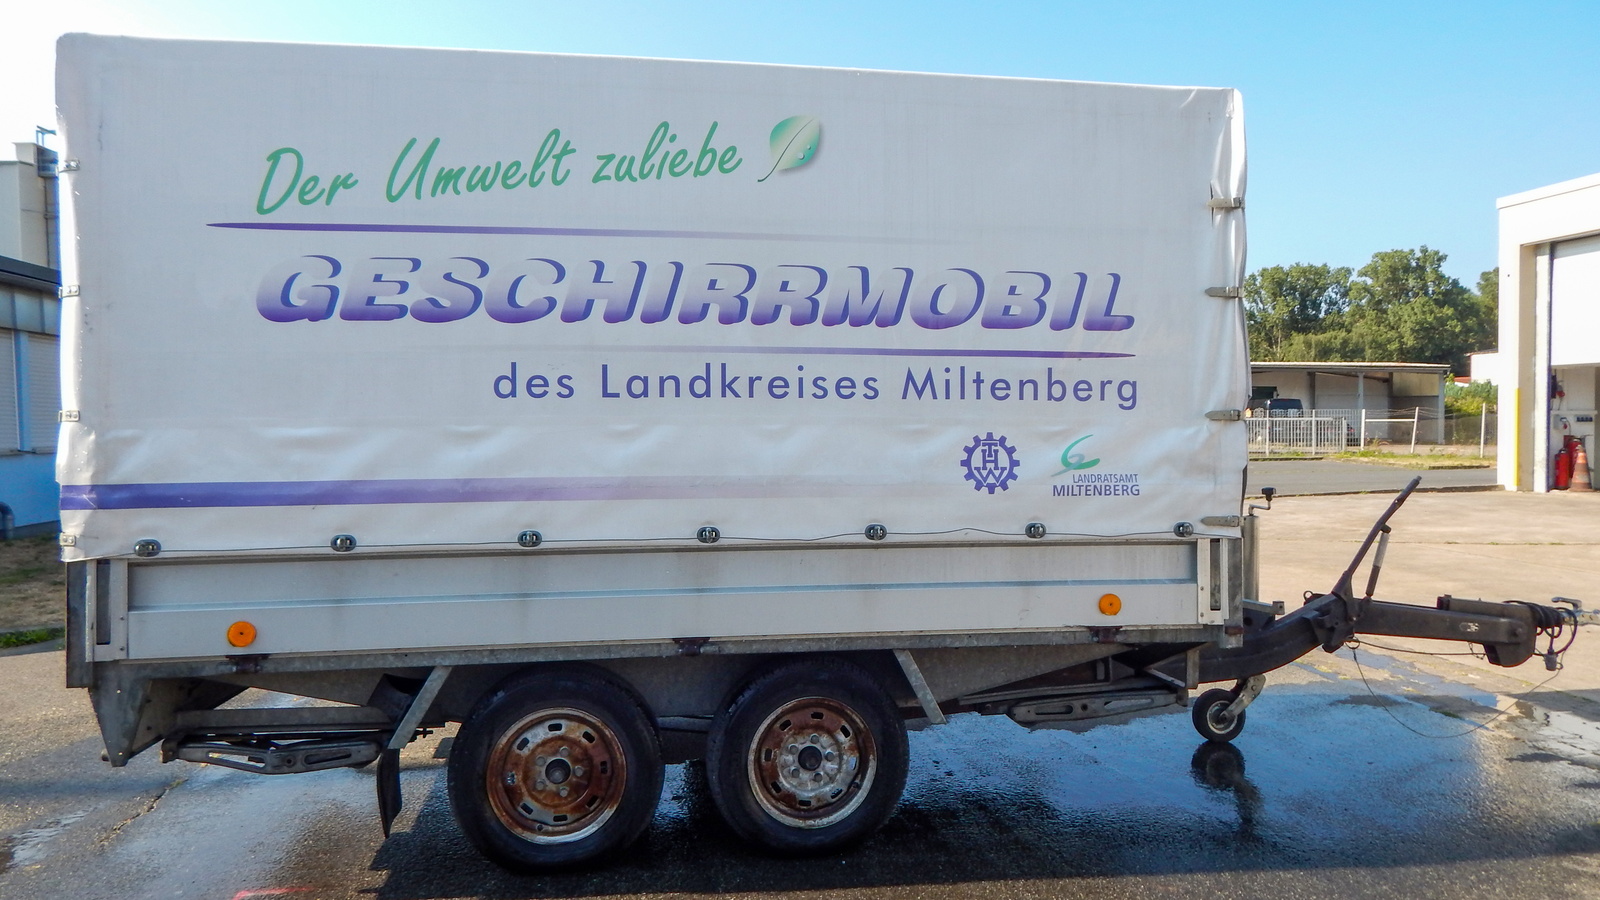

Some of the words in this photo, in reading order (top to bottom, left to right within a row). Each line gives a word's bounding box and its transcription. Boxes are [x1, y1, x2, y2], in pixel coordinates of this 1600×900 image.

[256, 147, 359, 215] Der
[385, 128, 577, 203] Umwelt
[592, 121, 743, 184] zuliebe
[256, 255, 1135, 332] GESCHIRRMOBIL
[493, 362, 575, 399] des
[601, 364, 880, 400] Landkreises
[901, 366, 1138, 411] Miltenberg
[1052, 484, 1140, 497] MILTENBERG
[1072, 473, 1139, 484] LANDRATSAMT
